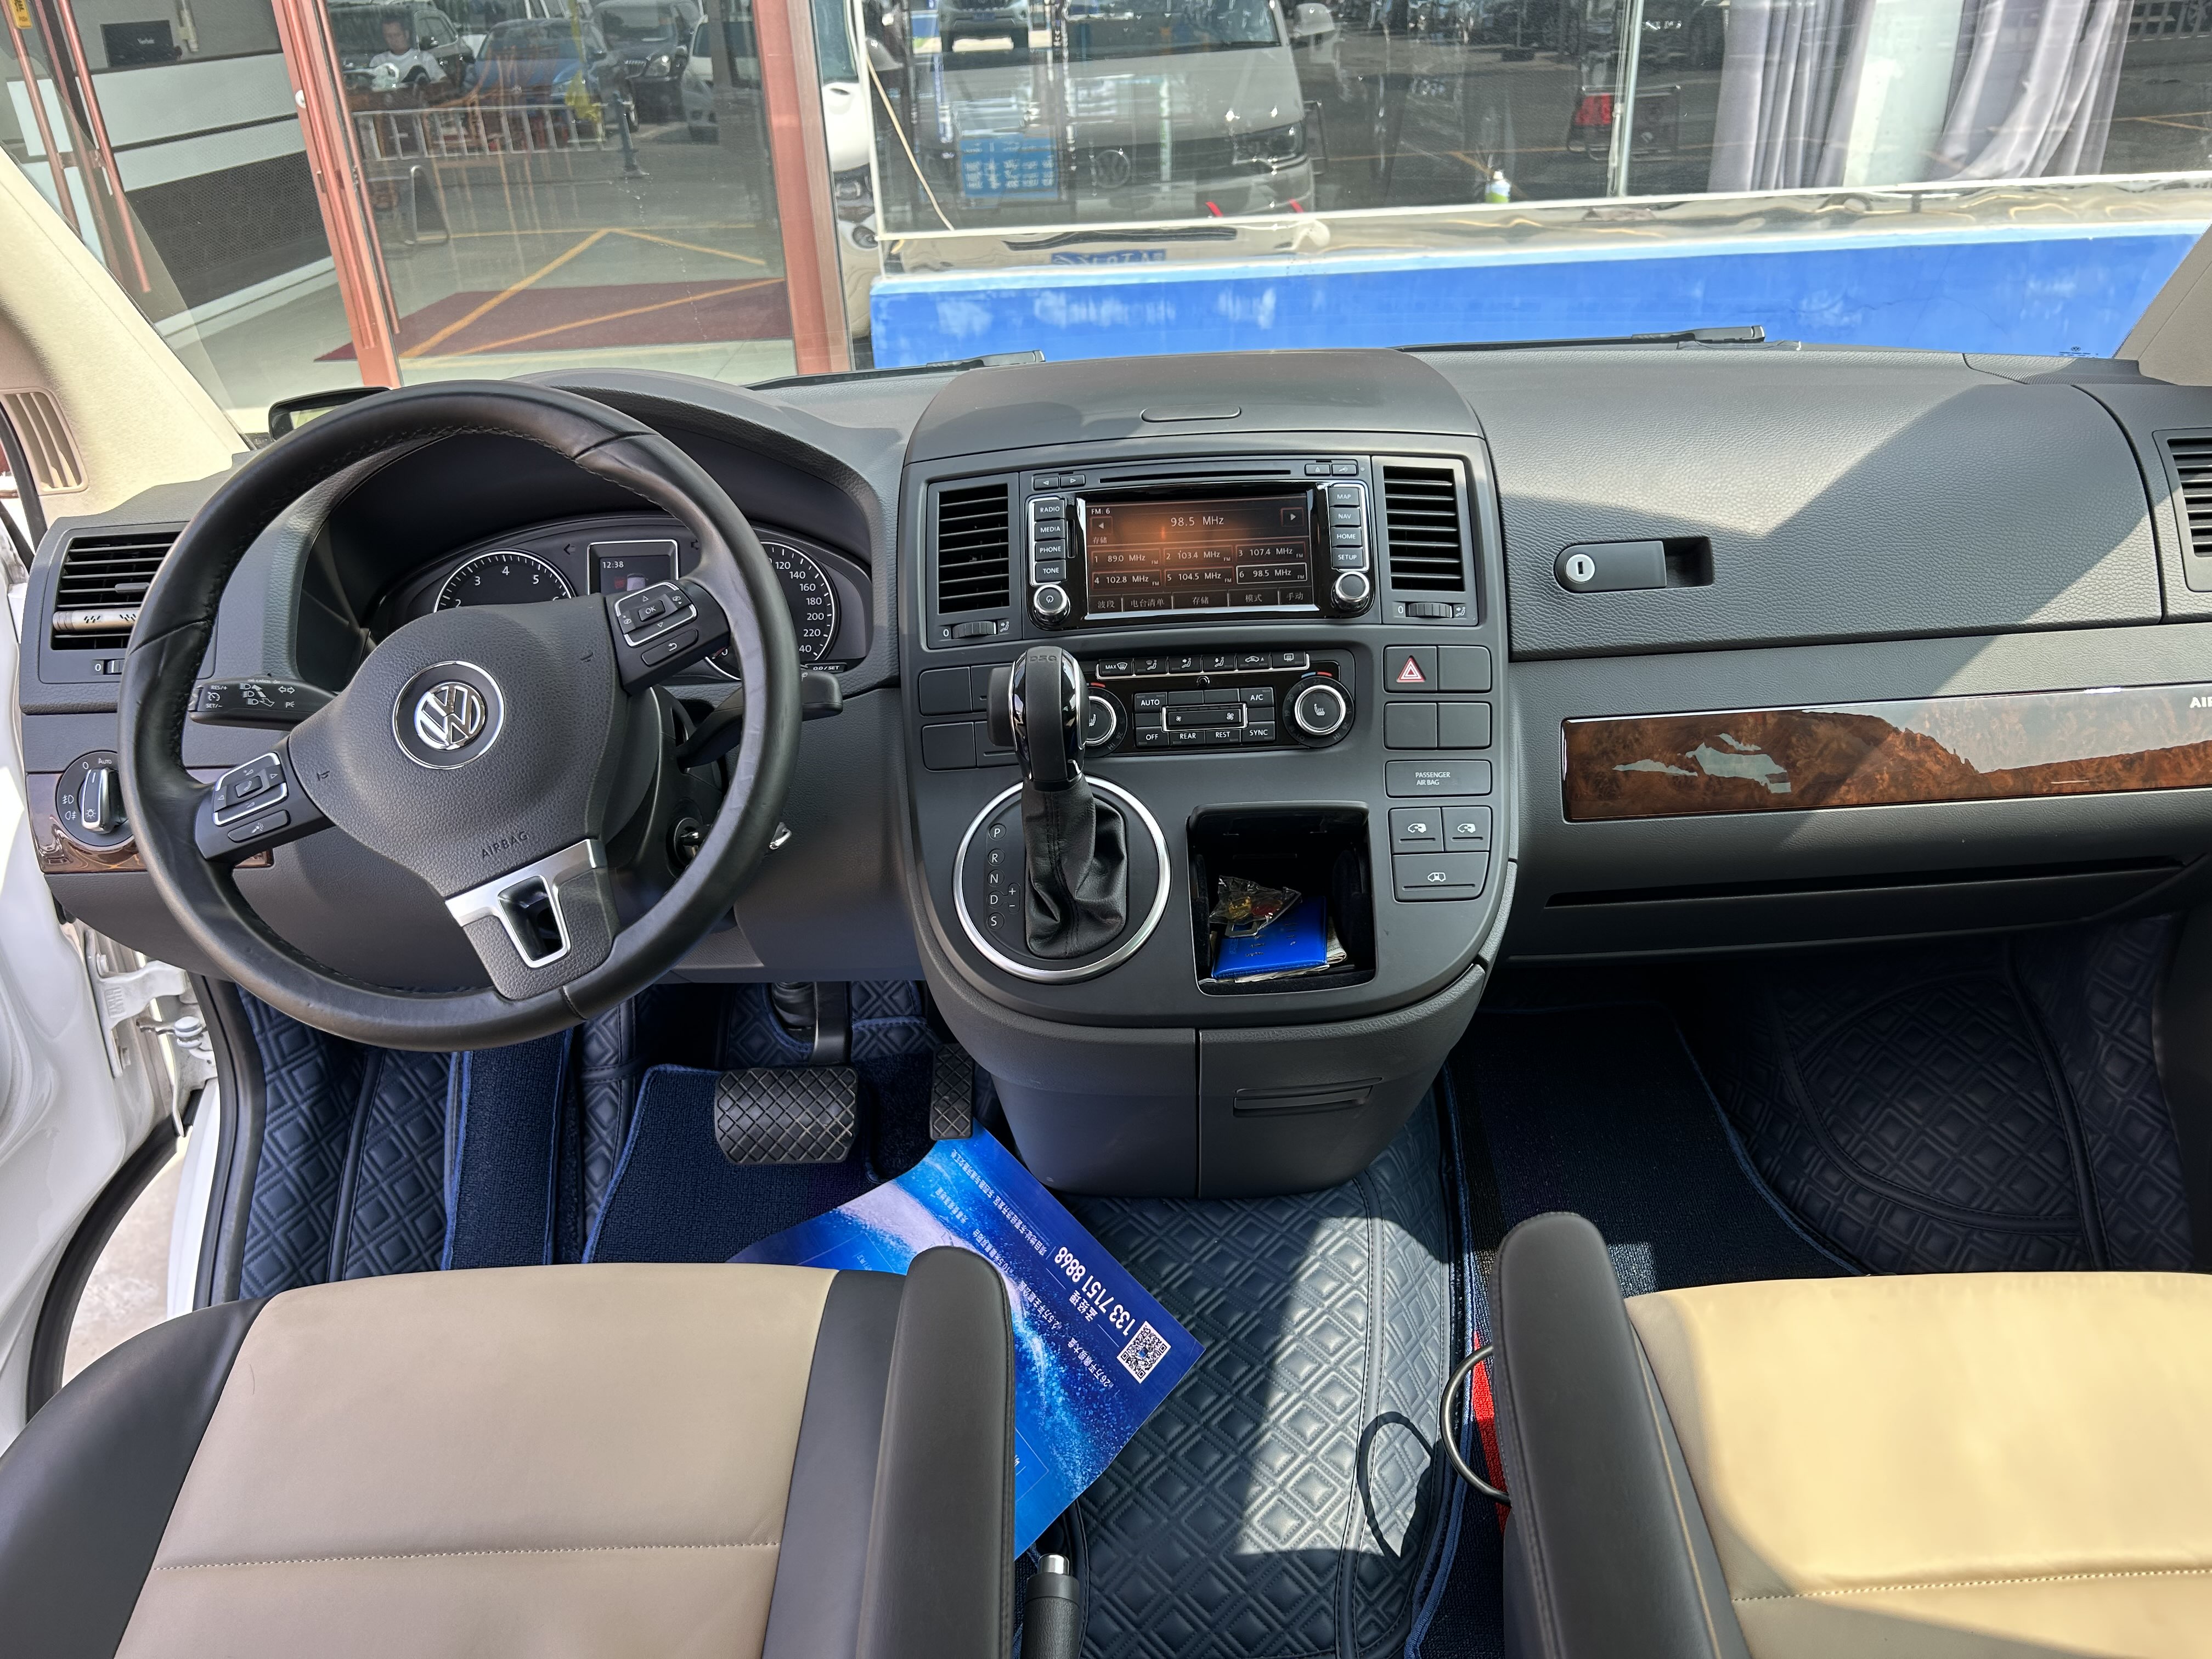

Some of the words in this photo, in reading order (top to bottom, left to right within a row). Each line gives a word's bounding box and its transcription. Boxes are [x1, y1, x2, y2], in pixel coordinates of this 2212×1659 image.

[1171, 517, 1195, 527] 98.5
[1203, 516, 1224, 525] MHz
[1178, 551, 1198, 560] 103.4
[602, 561, 624, 569] 12:38
[775, 561, 791, 569] 120
[501, 566, 510, 576] 4
[789, 571, 806, 579] 140
[474, 576, 481, 586] 3
[533, 574, 540, 584] 5
[1178, 572, 1199, 581] 104.5
[799, 583, 816, 591] 160
[1193, 596, 1209, 605] 存储
[1245, 594, 1262, 602] 模式
[1286, 592, 1304, 601] 手动
[806, 597, 822, 606] 180
[1097, 600, 1115, 609] 波段
[1131, 598, 1165, 608] 电台清单
[645, 606, 657, 614] OK
[806, 612, 824, 621] 200
[803, 629, 821, 637] 220
[799, 645, 812, 653] 40
[1250, 693, 1263, 702] A/C
[1249, 729, 1268, 737] SYNC
[994, 828, 1001, 838] P
[482, 831, 529, 859] AIRBAG
[991, 853, 998, 863] R
[990, 873, 998, 884] N
[990, 895, 998, 905] D
[991, 916, 997, 927] S
[1053, 1245, 1086, 1283] 8868
[1081, 1274, 1114, 1313] 7151
[1067, 1289, 1098, 1322] 孟经理
[1108, 1302, 1136, 1336] 133
